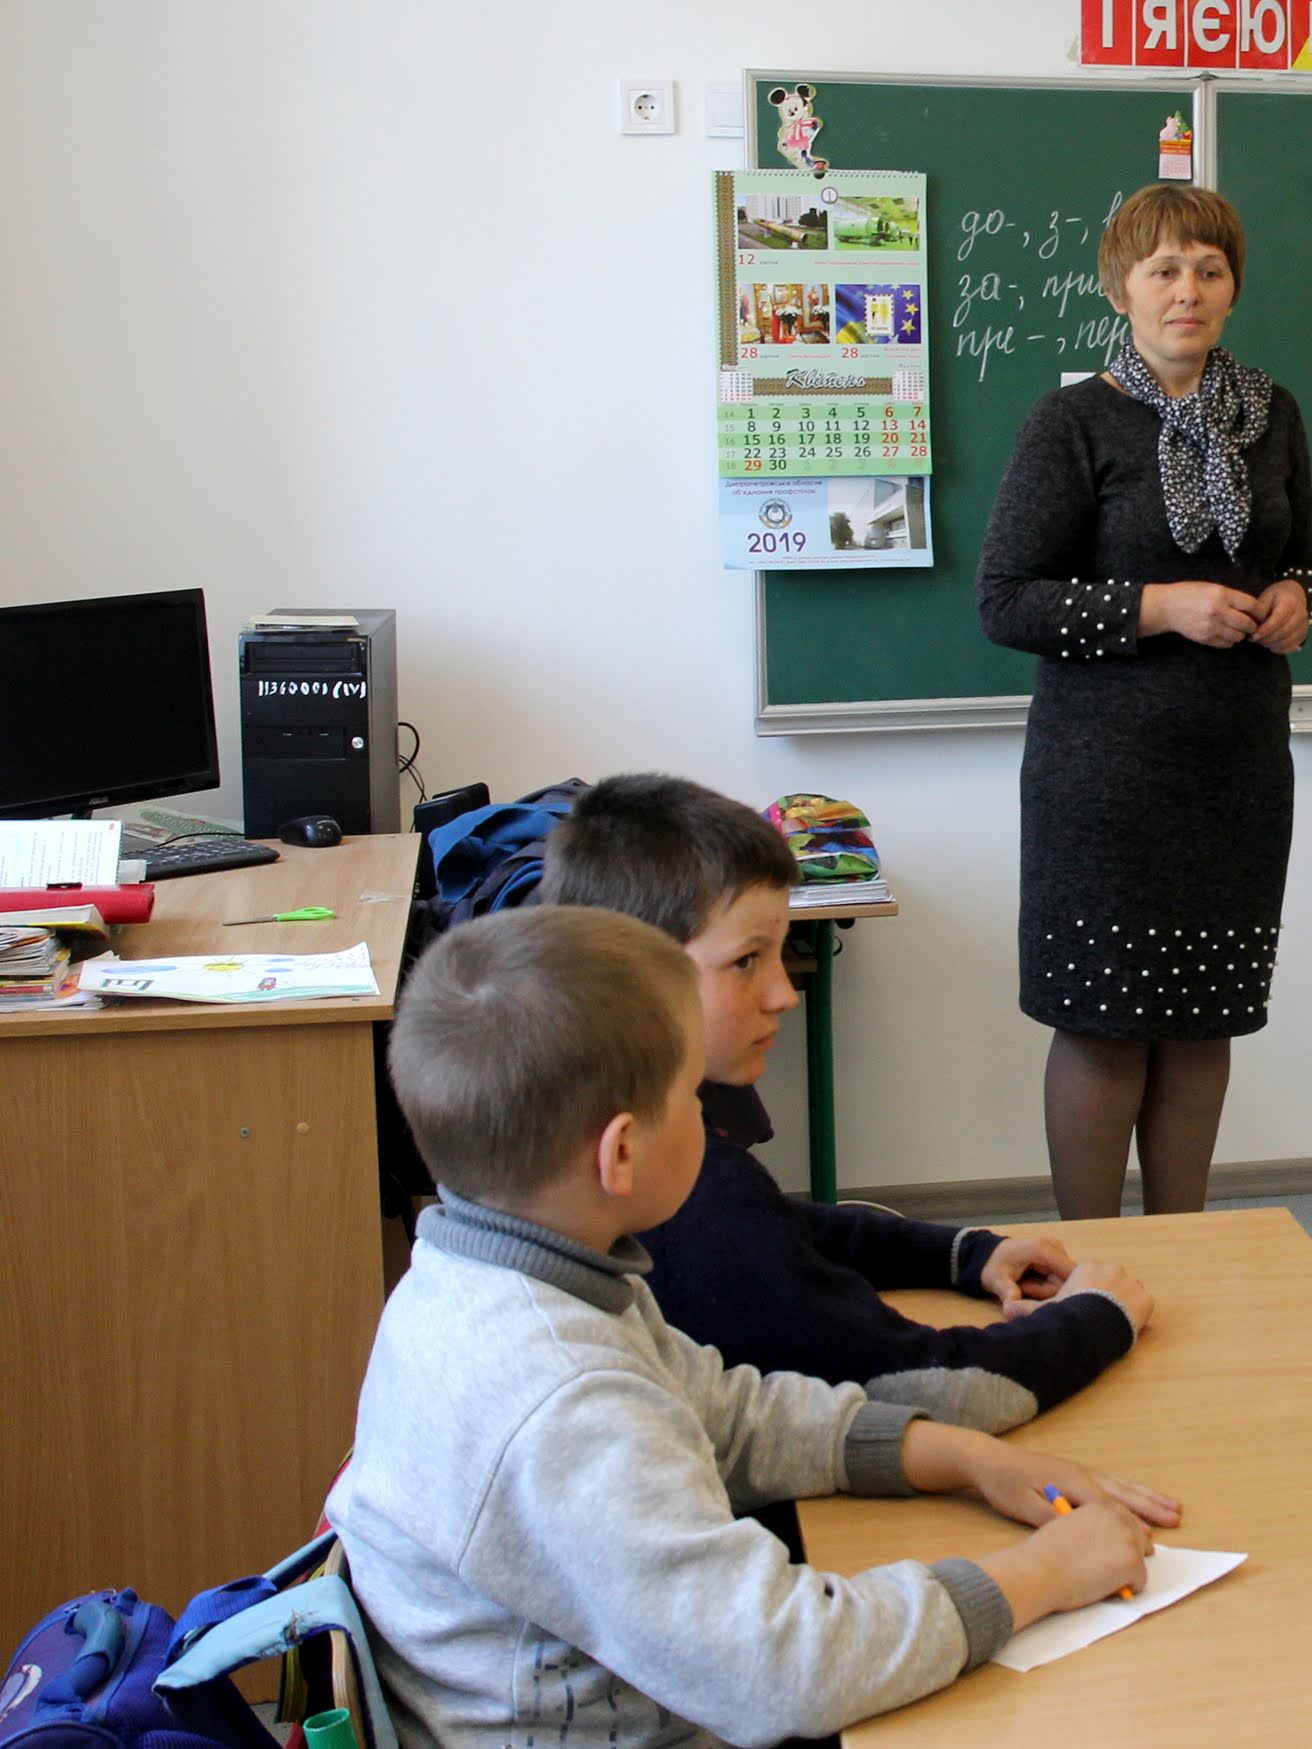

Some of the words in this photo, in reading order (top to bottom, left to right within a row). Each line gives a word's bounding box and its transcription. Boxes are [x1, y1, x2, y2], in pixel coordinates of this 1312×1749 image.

[738, 254, 755, 265] 12
[741, 347, 758, 359] 28
[841, 347, 859, 359] 28
[785, 368, 867, 390] Квітень
[748, 409, 754, 418] 1
[773, 409, 780, 418] 2
[802, 408, 810, 418] 3
[828, 408, 837, 417] 4
[857, 407, 865, 417] 5
[885, 407, 893, 417] 6
[914, 407, 921, 417] 7
[748, 422, 756, 432] 8
[773, 422, 780, 431] 9
[799, 421, 814, 431] 10
[826, 421, 840, 431] 11
[854, 421, 869, 430] 12
[882, 421, 897, 430] 13
[910, 420, 925, 430] 14
[744, 435, 760, 445] 15
[769, 435, 785, 445] 16
[800, 434, 814, 444] 17
[826, 434, 841, 444] 18
[854, 434, 870, 444] 19
[882, 434, 898, 443] 20
[911, 433, 926, 443] 21
[745, 449, 761, 458] 22
[769, 448, 786, 458] 23
[800, 448, 815, 457] 24
[826, 448, 842, 457] 25
[855, 447, 870, 457] 26
[883, 447, 899, 456] 27
[912, 446, 927, 456] 28
[745, 460, 762, 471] 29
[770, 460, 786, 470] 30
[747, 532, 807, 553] 2019
